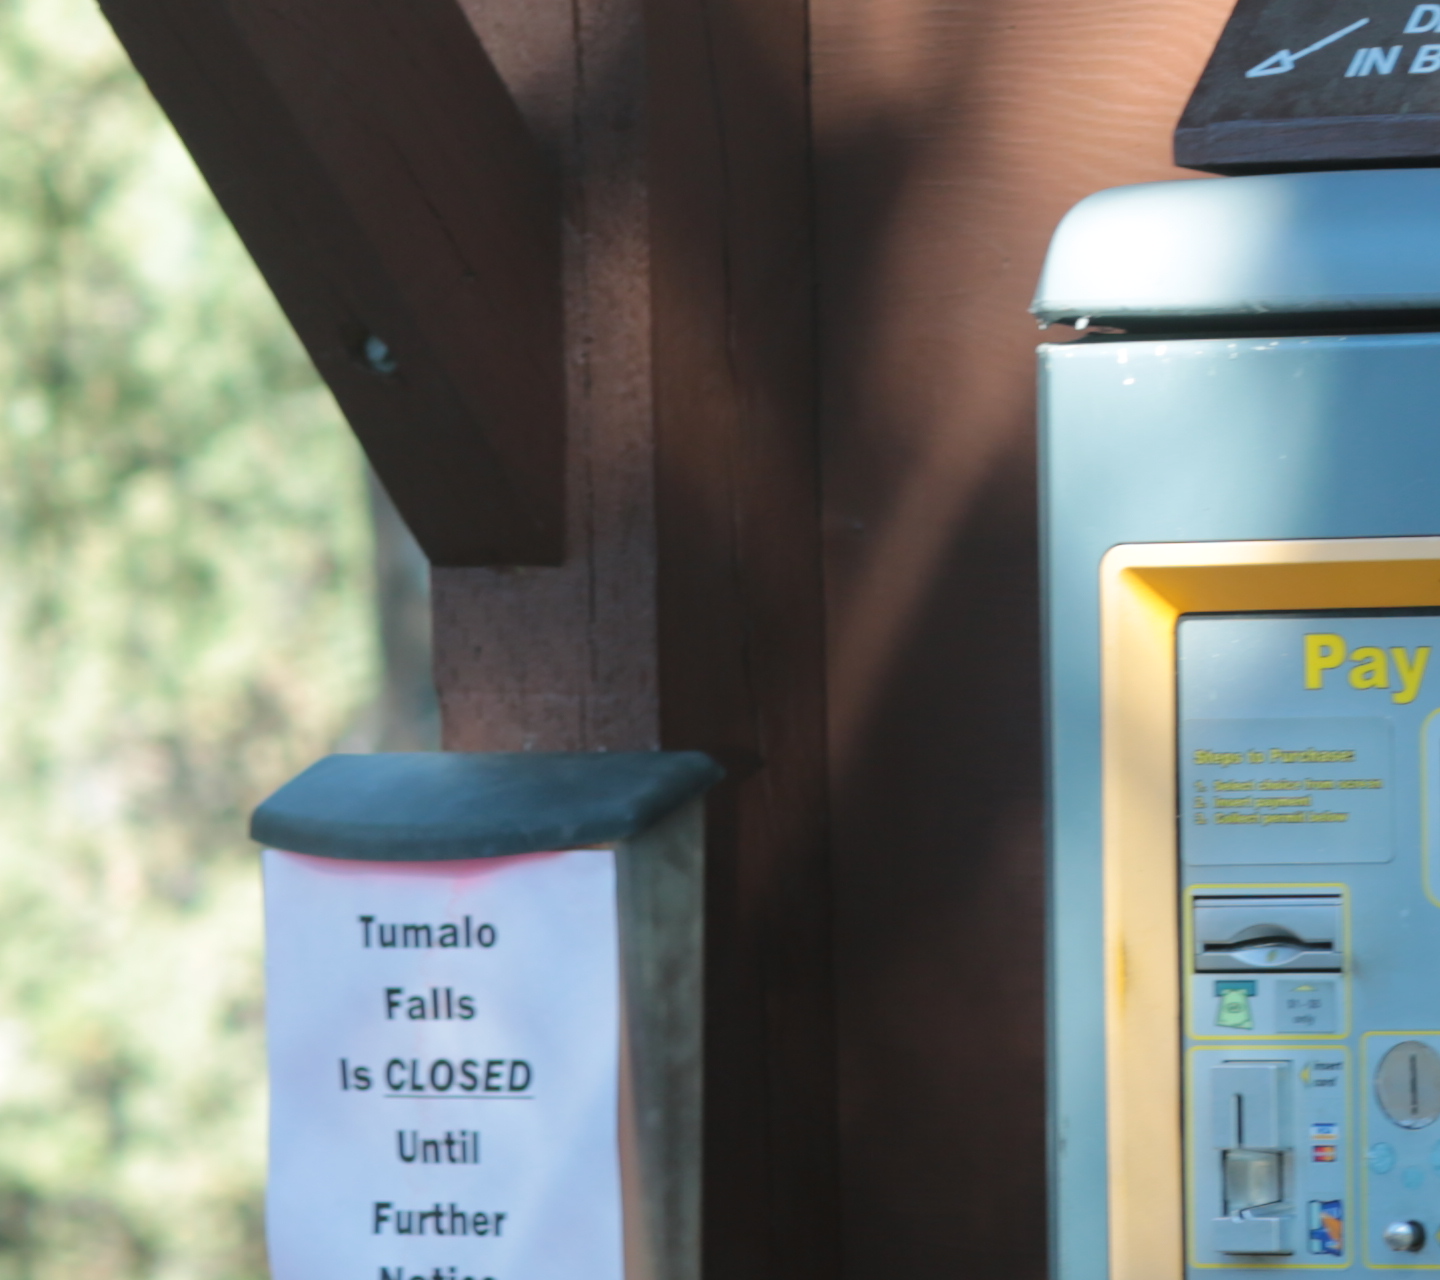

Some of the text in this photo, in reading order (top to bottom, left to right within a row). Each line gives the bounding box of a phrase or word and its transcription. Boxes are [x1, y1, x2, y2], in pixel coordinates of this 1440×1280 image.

[1344, 44, 1403, 78] IN
[1303, 633, 1432, 705] Pay
[359, 915, 498, 948] Tumalo
[384, 987, 477, 1021] Falls
[340, 1058, 534, 1093] Is CLOSED
[396, 1130, 480, 1164] Until
[372, 1202, 507, 1236] Further
